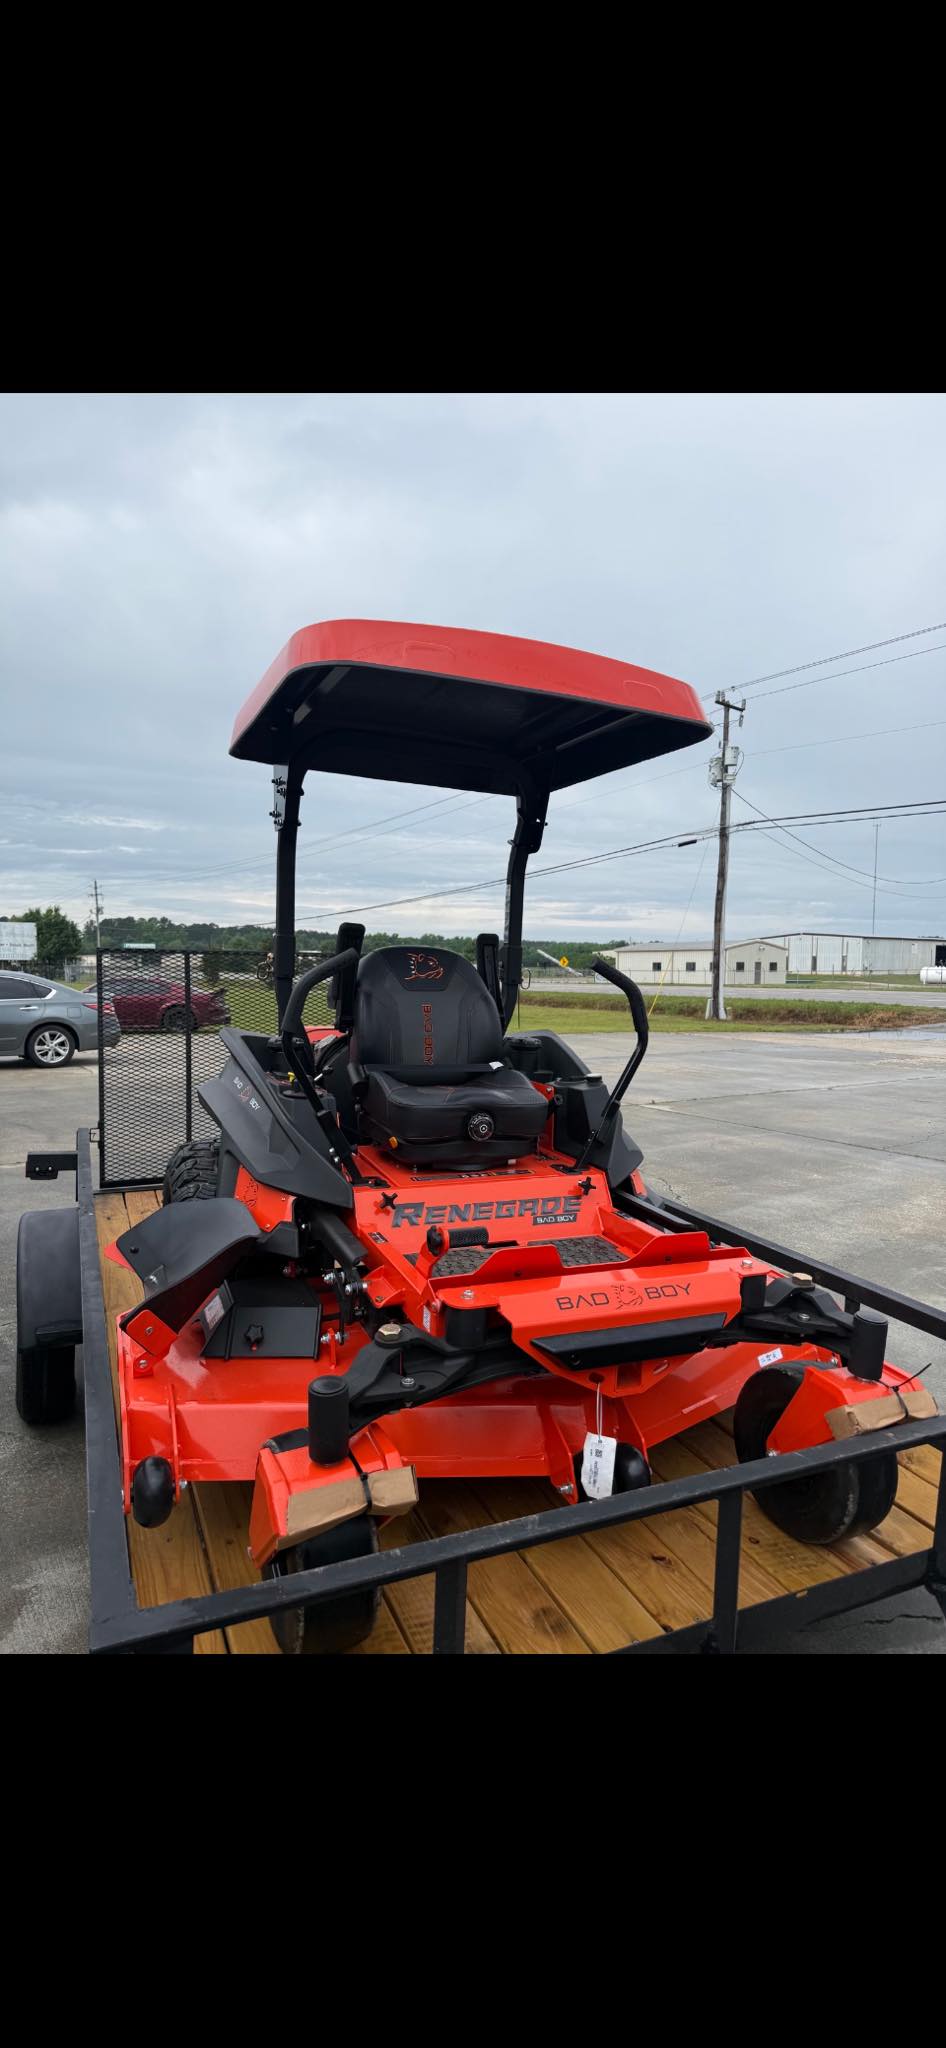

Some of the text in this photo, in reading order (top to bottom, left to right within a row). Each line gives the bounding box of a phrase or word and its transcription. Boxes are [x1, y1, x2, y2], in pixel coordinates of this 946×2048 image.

[392, 1196, 582, 1228] RENEGADE
[536, 1214, 576, 1224] BAD BOY
[556, 1283, 692, 1311] BAD BOY
